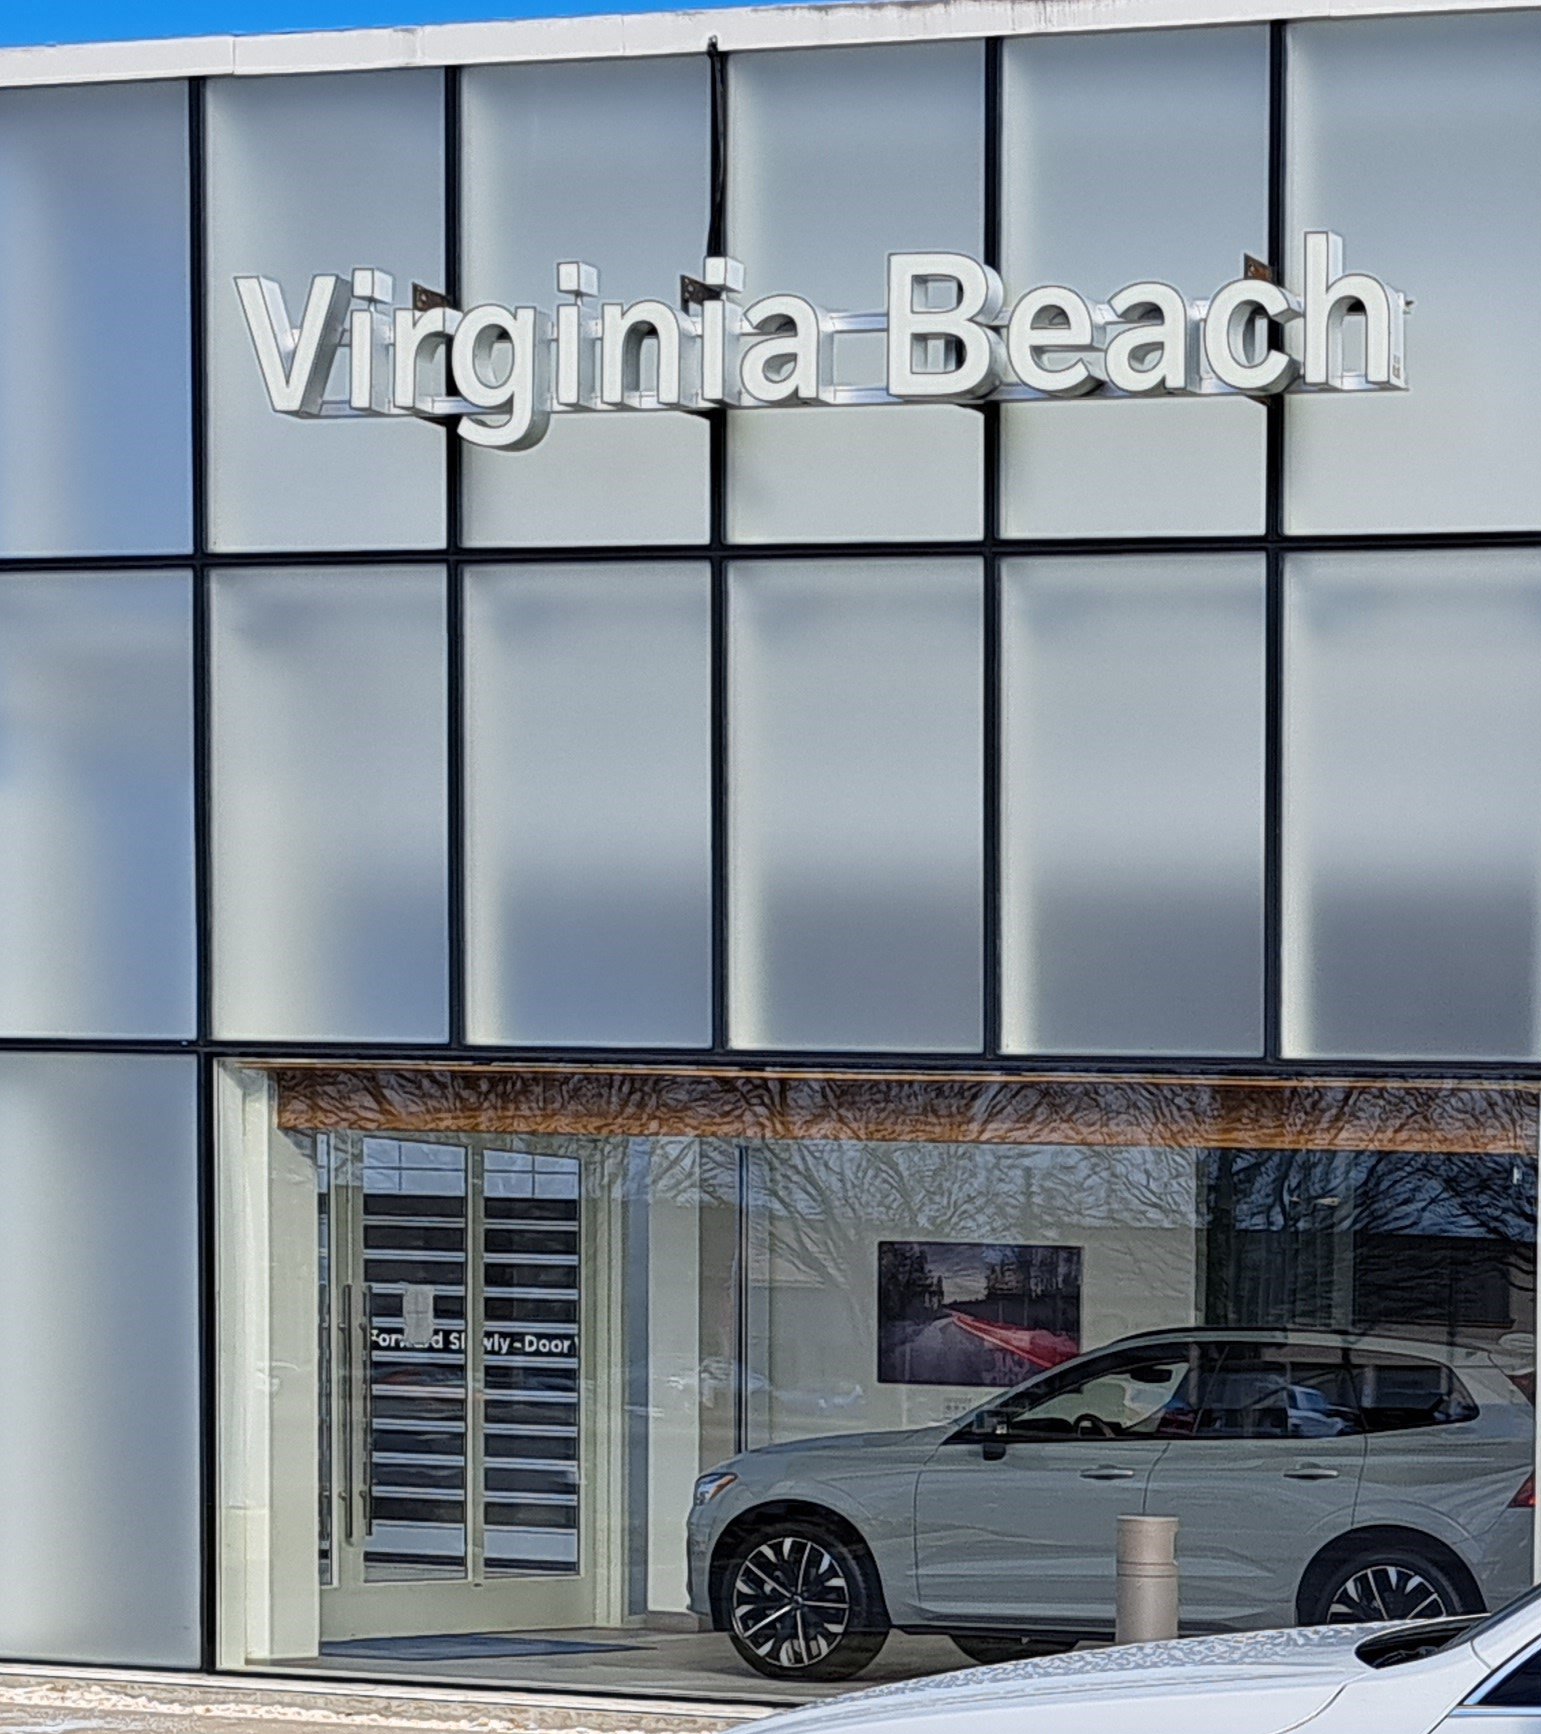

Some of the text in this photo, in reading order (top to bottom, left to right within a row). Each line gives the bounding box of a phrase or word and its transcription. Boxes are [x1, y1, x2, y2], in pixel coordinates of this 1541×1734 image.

[233, 231, 1405, 453] Virginia Beach
[524, 1335, 571, 1353] Door
